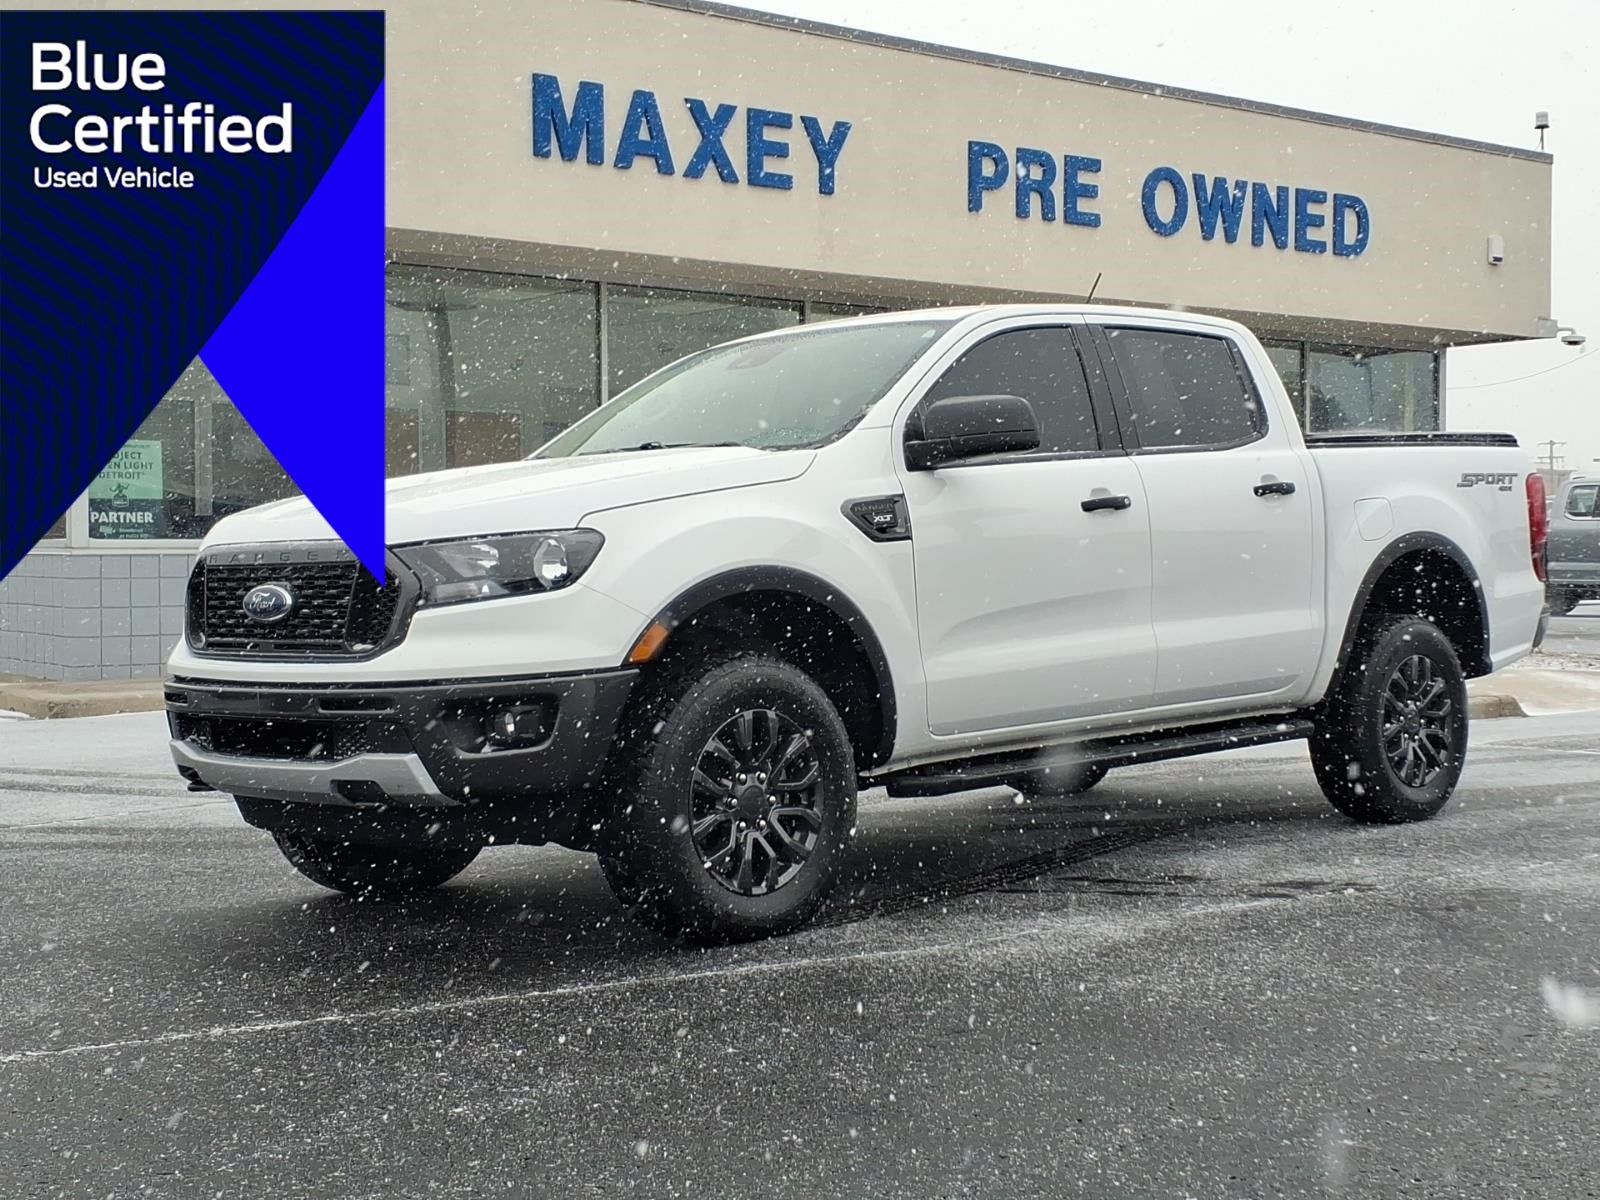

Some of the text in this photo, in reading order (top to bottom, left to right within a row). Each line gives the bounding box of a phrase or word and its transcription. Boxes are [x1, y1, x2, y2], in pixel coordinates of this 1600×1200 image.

[532, 72, 1371, 257] MAXEY PRE OWNED
[123, 461, 153, 470] LIGHT
[1456, 473, 1518, 487] SPORT
[90, 511, 154, 523] PARTNER
[873, 514, 893, 522] XLT
[208, 550, 351, 565] RANGER
[249, 591, 276, 611] Ford
